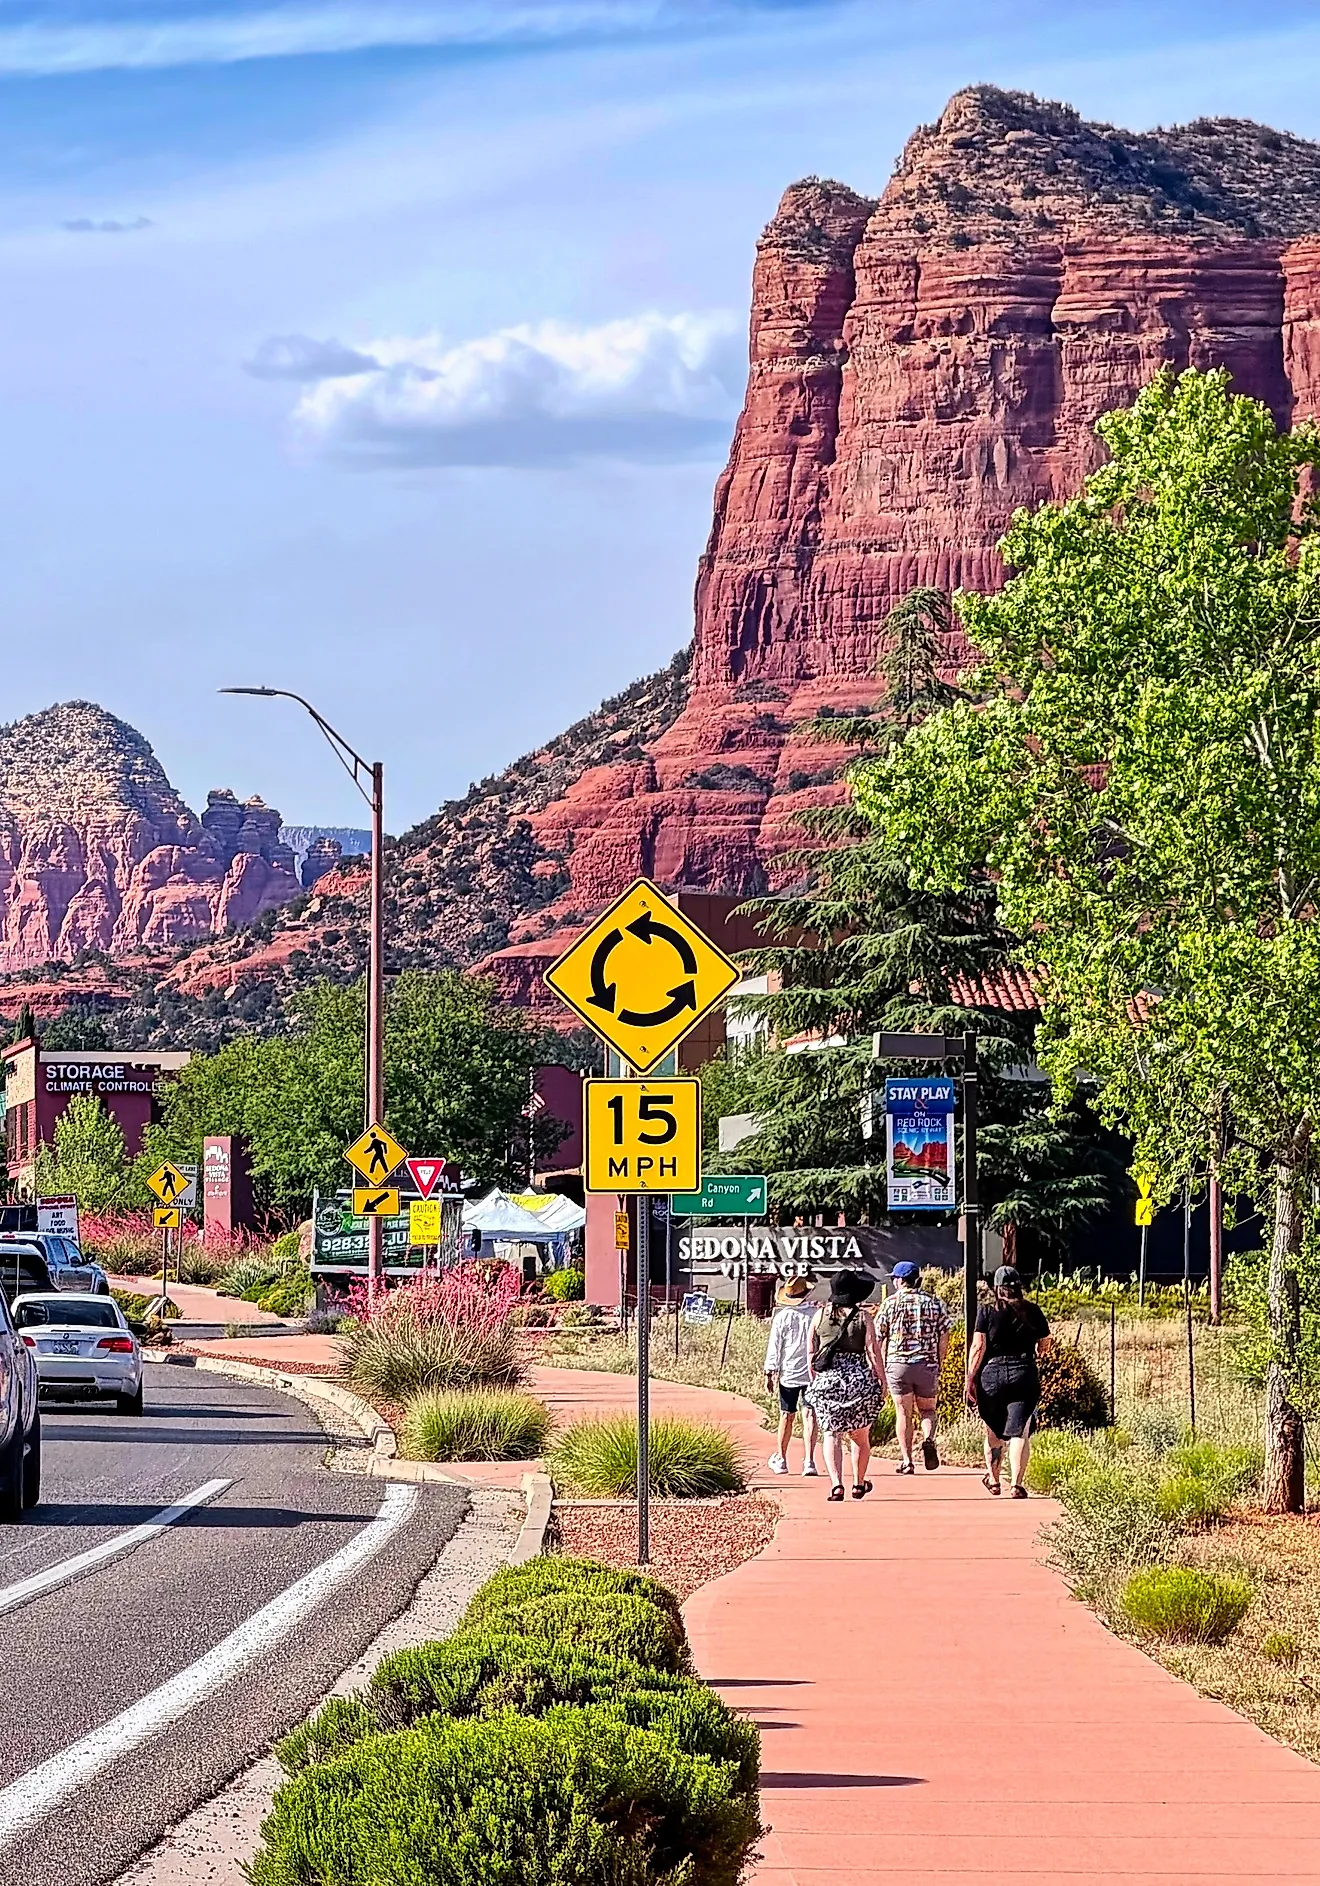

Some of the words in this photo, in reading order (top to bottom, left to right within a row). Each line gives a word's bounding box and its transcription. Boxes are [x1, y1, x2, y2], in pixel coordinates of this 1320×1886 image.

[45, 1065, 125, 1079] STORAGE
[45, 1081, 93, 1092] CLIMATE
[888, 1086, 919, 1101] STAY
[920, 1086, 951, 1100] PLAY
[607, 1095, 678, 1146] 15
[897, 1117, 916, 1128] RED
[917, 1117, 943, 1128] ROCK
[608, 1156, 677, 1178] MPH
[707, 1183, 740, 1195] Canyon
[173, 1198, 193, 1206] ONLY
[701, 1197, 714, 1208] Rd
[51, 1211, 64, 1219] ART
[678, 1236, 776, 1260] SEDONA
[780, 1235, 863, 1260] VISTA
